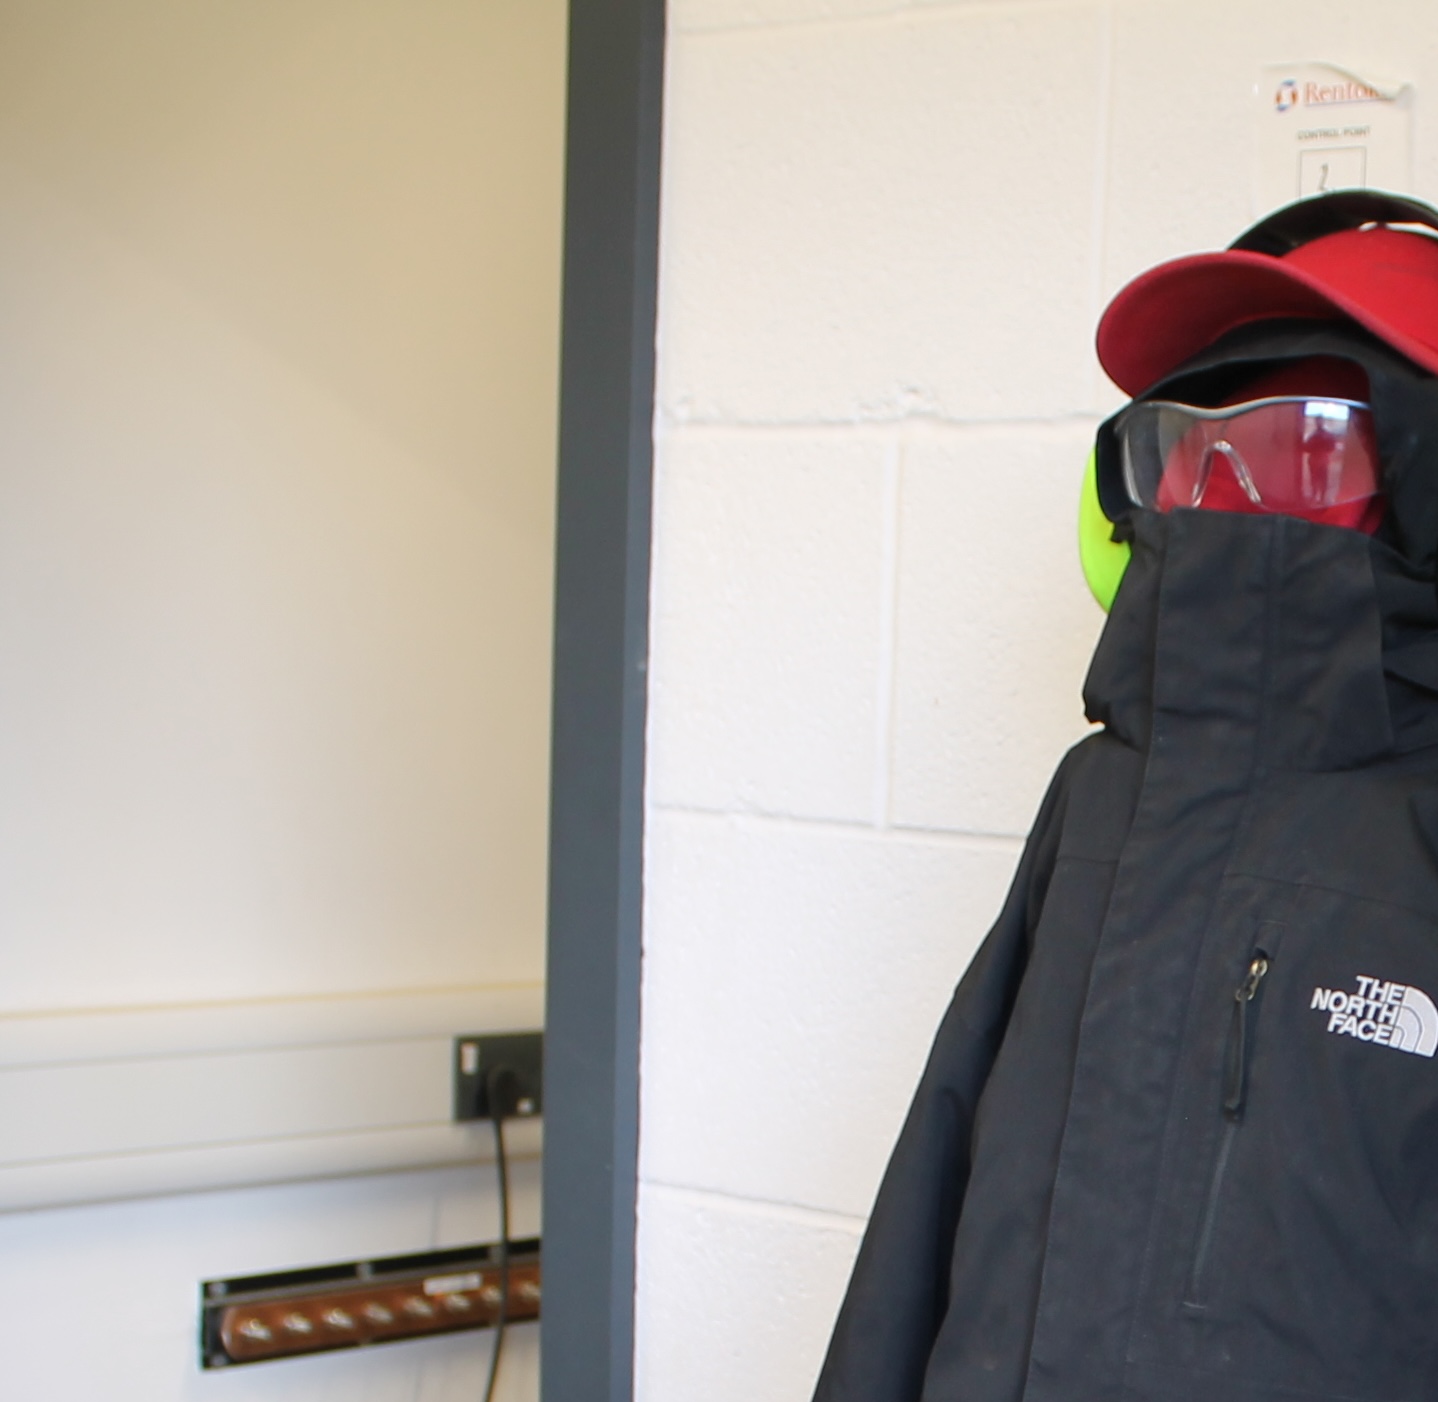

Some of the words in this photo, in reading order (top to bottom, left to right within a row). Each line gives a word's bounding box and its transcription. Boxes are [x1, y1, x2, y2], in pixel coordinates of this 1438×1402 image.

[1310, 987, 1400, 1025] NORTH
[1356, 975, 1406, 1006] THE
[1327, 1013, 1394, 1046] FACE
